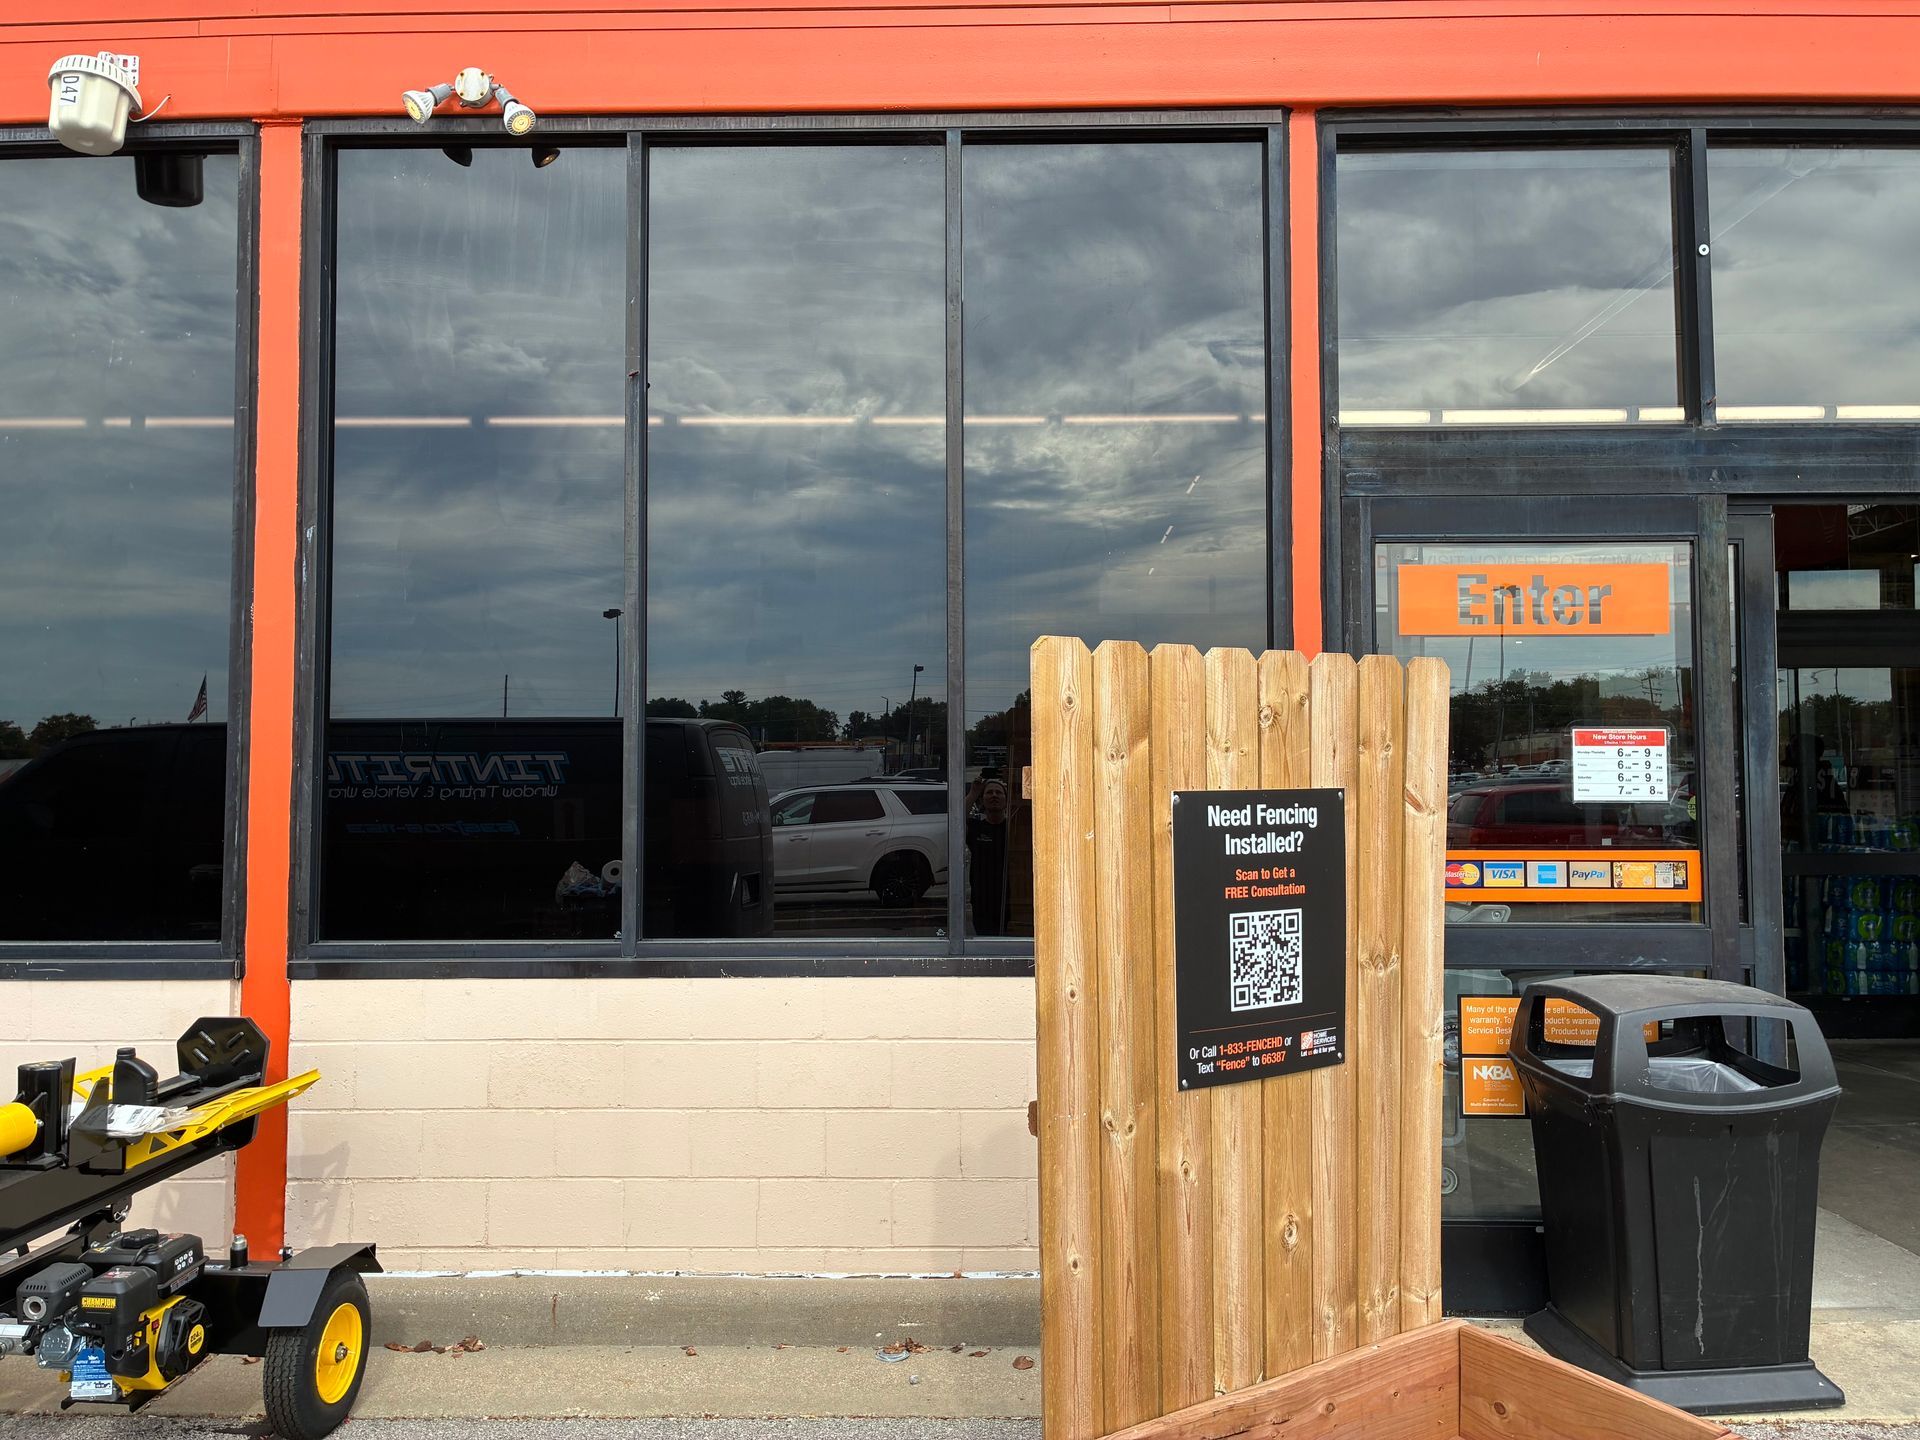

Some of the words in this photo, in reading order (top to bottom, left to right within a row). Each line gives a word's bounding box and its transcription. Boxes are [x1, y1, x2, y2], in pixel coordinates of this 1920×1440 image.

[60, 75, 79, 104] D47
[1457, 573, 1613, 626] Enter
[1617, 748, 1624, 757] 6
[1644, 748, 1651, 757] 9
[1617, 760, 1624, 770] 6
[1645, 760, 1651, 770] 9
[1617, 773, 1624, 782] 6
[1645, 773, 1651, 782] 9
[1618, 786, 1625, 795] 7
[1649, 786, 1656, 795] 8
[1207, 805, 1251, 827] Need
[1256, 803, 1318, 828] Fencing
[1225, 831, 1304, 855] Installed?
[1236, 868, 1259, 881] Scan
[1261, 868, 1271, 880] to
[1272, 867, 1289, 879] Get
[1289, 868, 1296, 878] a
[1491, 870, 1517, 879] VISA
[1571, 870, 1606, 880] PayPal
[1225, 886, 1249, 899] FREE
[1251, 883, 1306, 898] Consultation
[1466, 1006, 1485, 1014] Many
[1470, 1017, 1502, 1025] warranty.
[1313, 1036, 1337, 1045] SERVICES
[1497, 1037, 1504, 1045] is
[1189, 1047, 1199, 1060] Or
[1201, 1045, 1217, 1058] Call
[1219, 1037, 1283, 1056] 1-833-FENCEHD
[1284, 1037, 1292, 1047] or
[1197, 1061, 1214, 1074] Text
[1216, 1057, 1250, 1072] “Fence”
[1252, 1056, 1260, 1066] to
[1261, 1051, 1286, 1065] 66387
[1473, 1065, 1515, 1081] NKBA
[82, 1297, 116, 1307] CHAMPION
